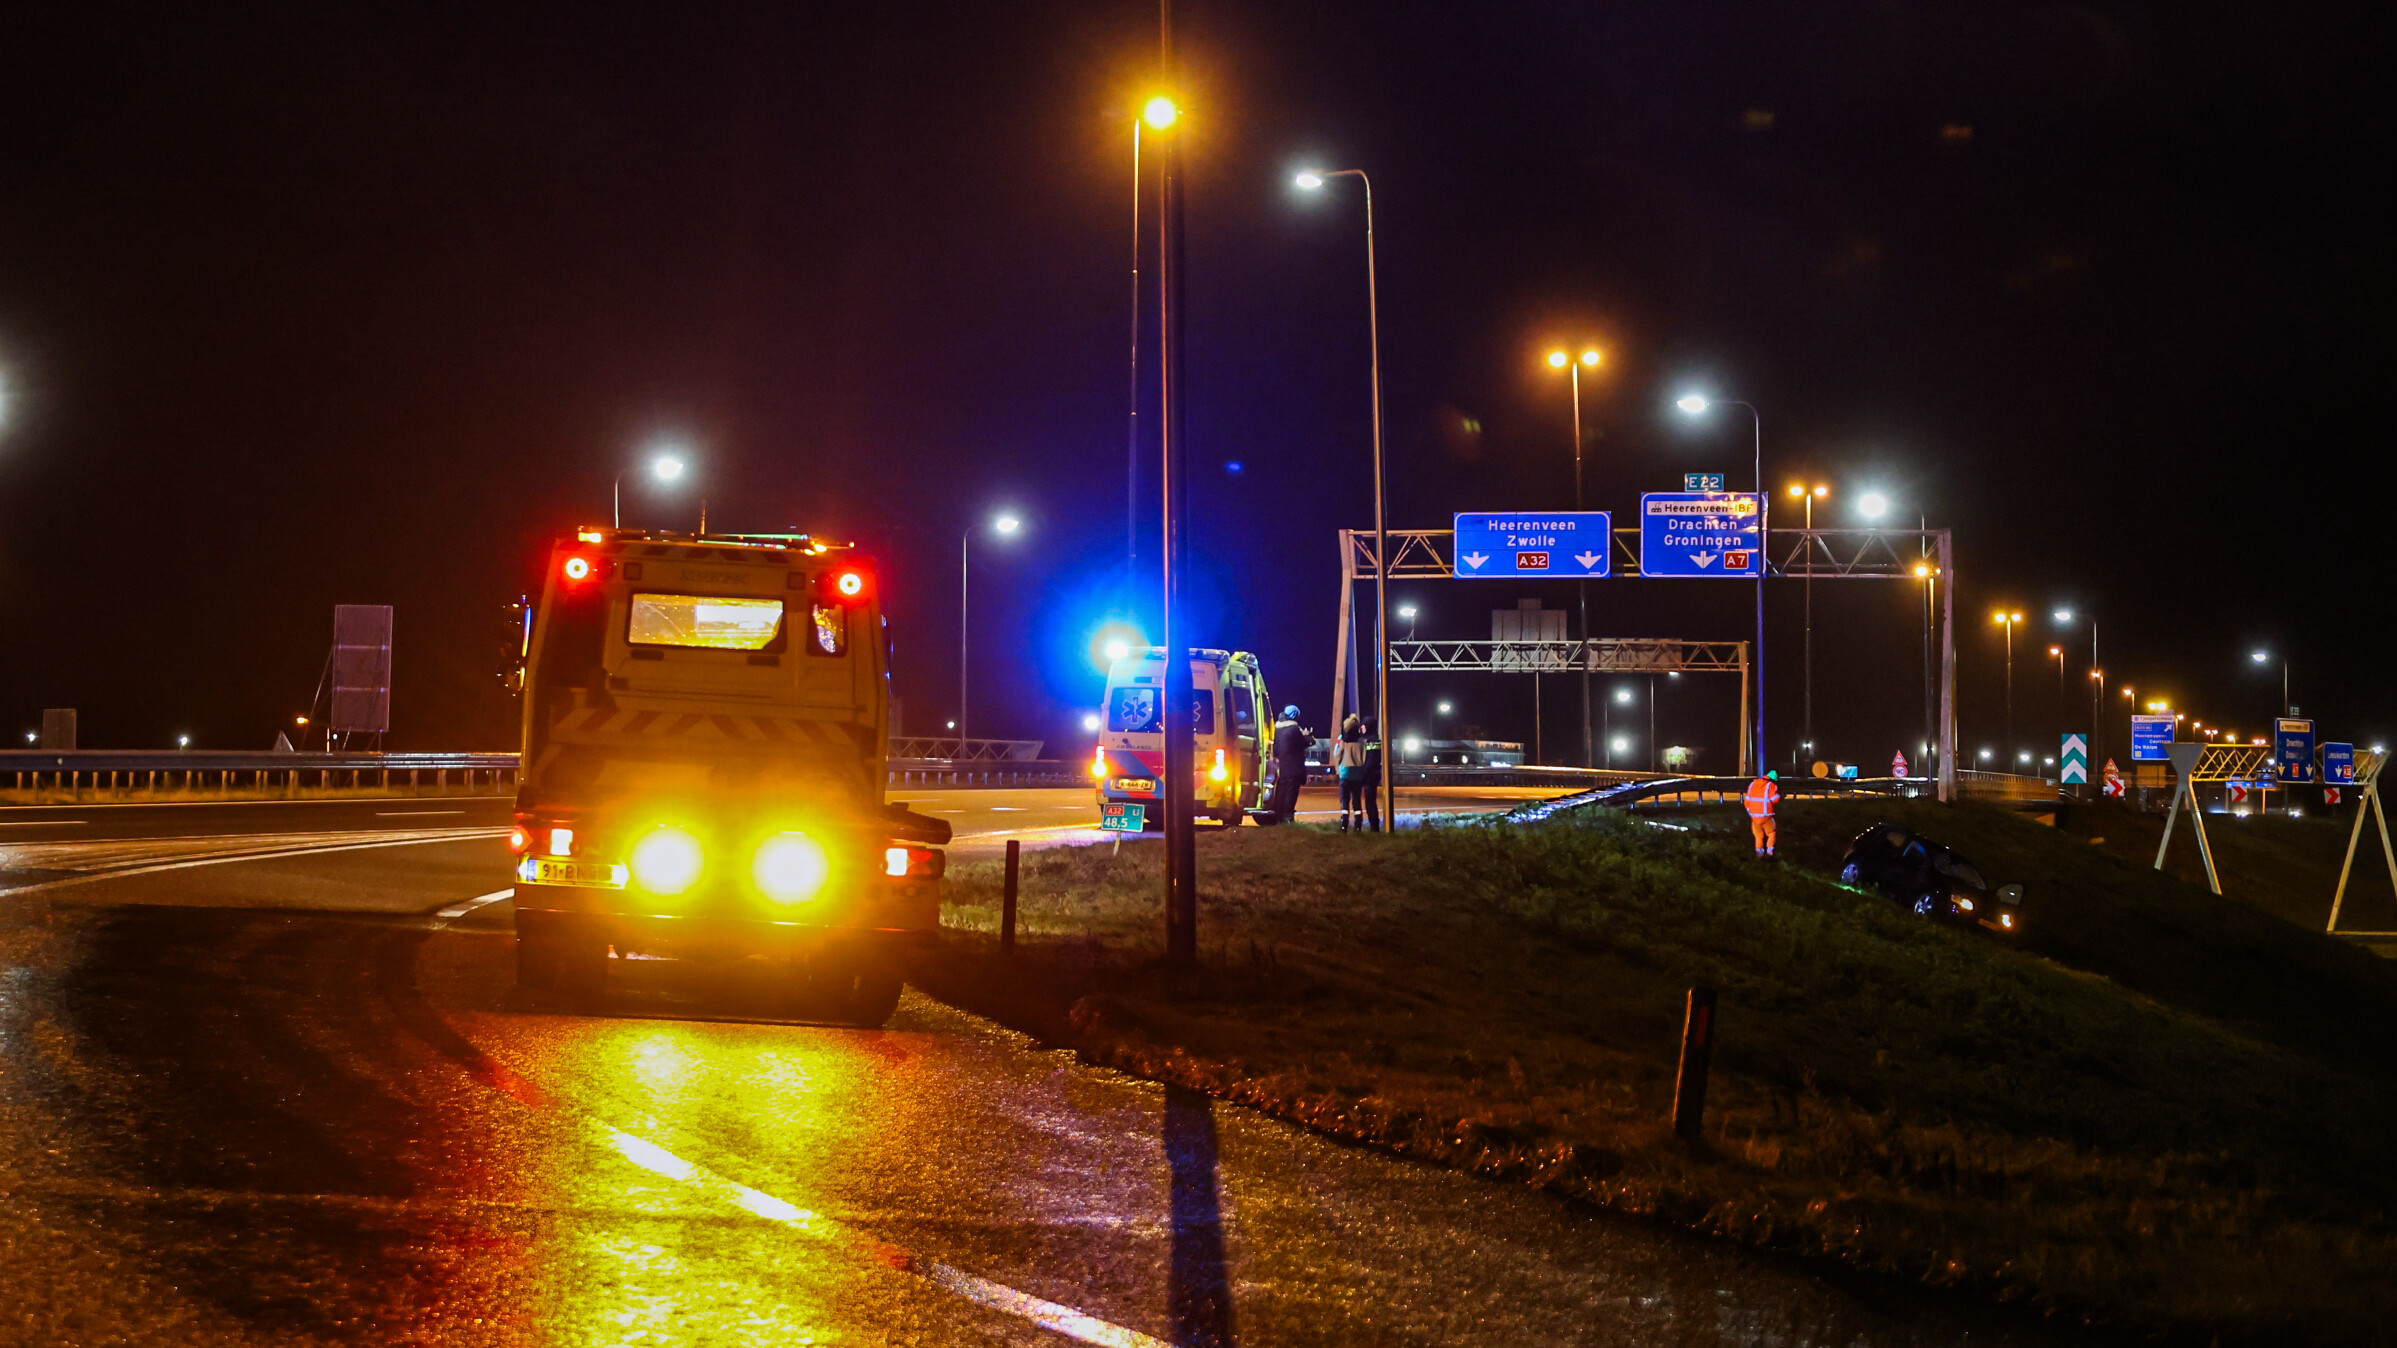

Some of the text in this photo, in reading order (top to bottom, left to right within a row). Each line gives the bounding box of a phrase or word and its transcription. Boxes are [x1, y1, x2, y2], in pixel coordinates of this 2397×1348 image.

[1488, 519, 1576, 531] Heerenveen
[1668, 518, 1738, 530] Drachten
[1507, 534, 1556, 547] Zwolle
[1664, 534, 1742, 550] Groningen
[1108, 807, 1122, 815] A32
